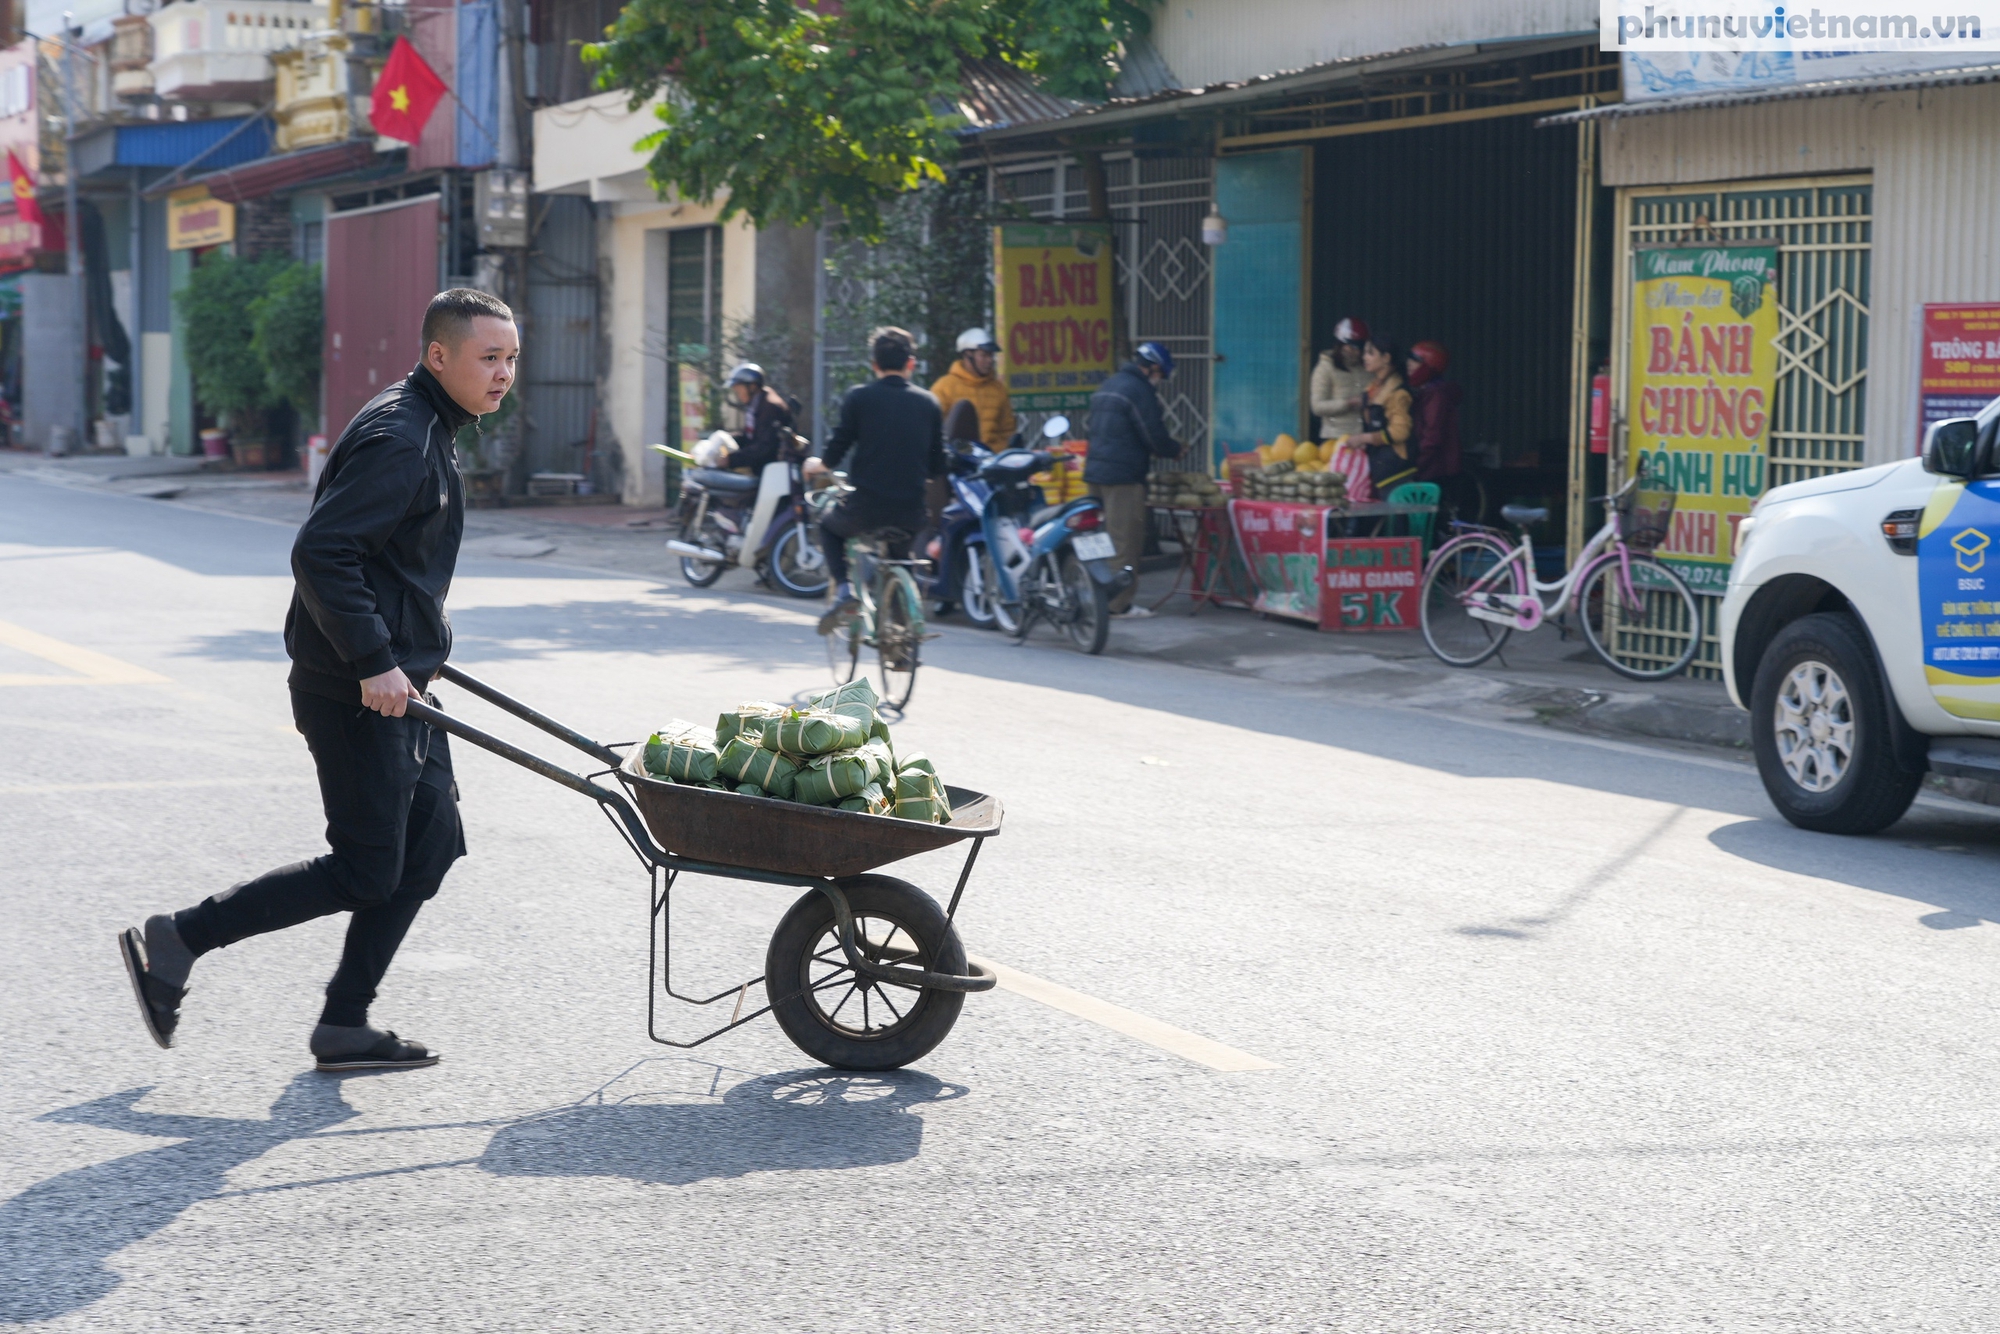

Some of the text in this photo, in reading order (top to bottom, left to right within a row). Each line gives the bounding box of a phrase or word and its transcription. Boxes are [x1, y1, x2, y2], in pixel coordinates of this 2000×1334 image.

[1018, 250, 1099, 309] BÁNH
[1649, 250, 1767, 277] Nam Phong
[1009, 316, 1110, 367] CHƯNG
[1647, 311, 1753, 376] BÁNH
[1930, 336, 1983, 359] THÔNG
[1640, 378, 1767, 439] CHƯNG
[1365, 571, 1415, 588] GIANG
[1340, 591, 1404, 626] 5K
